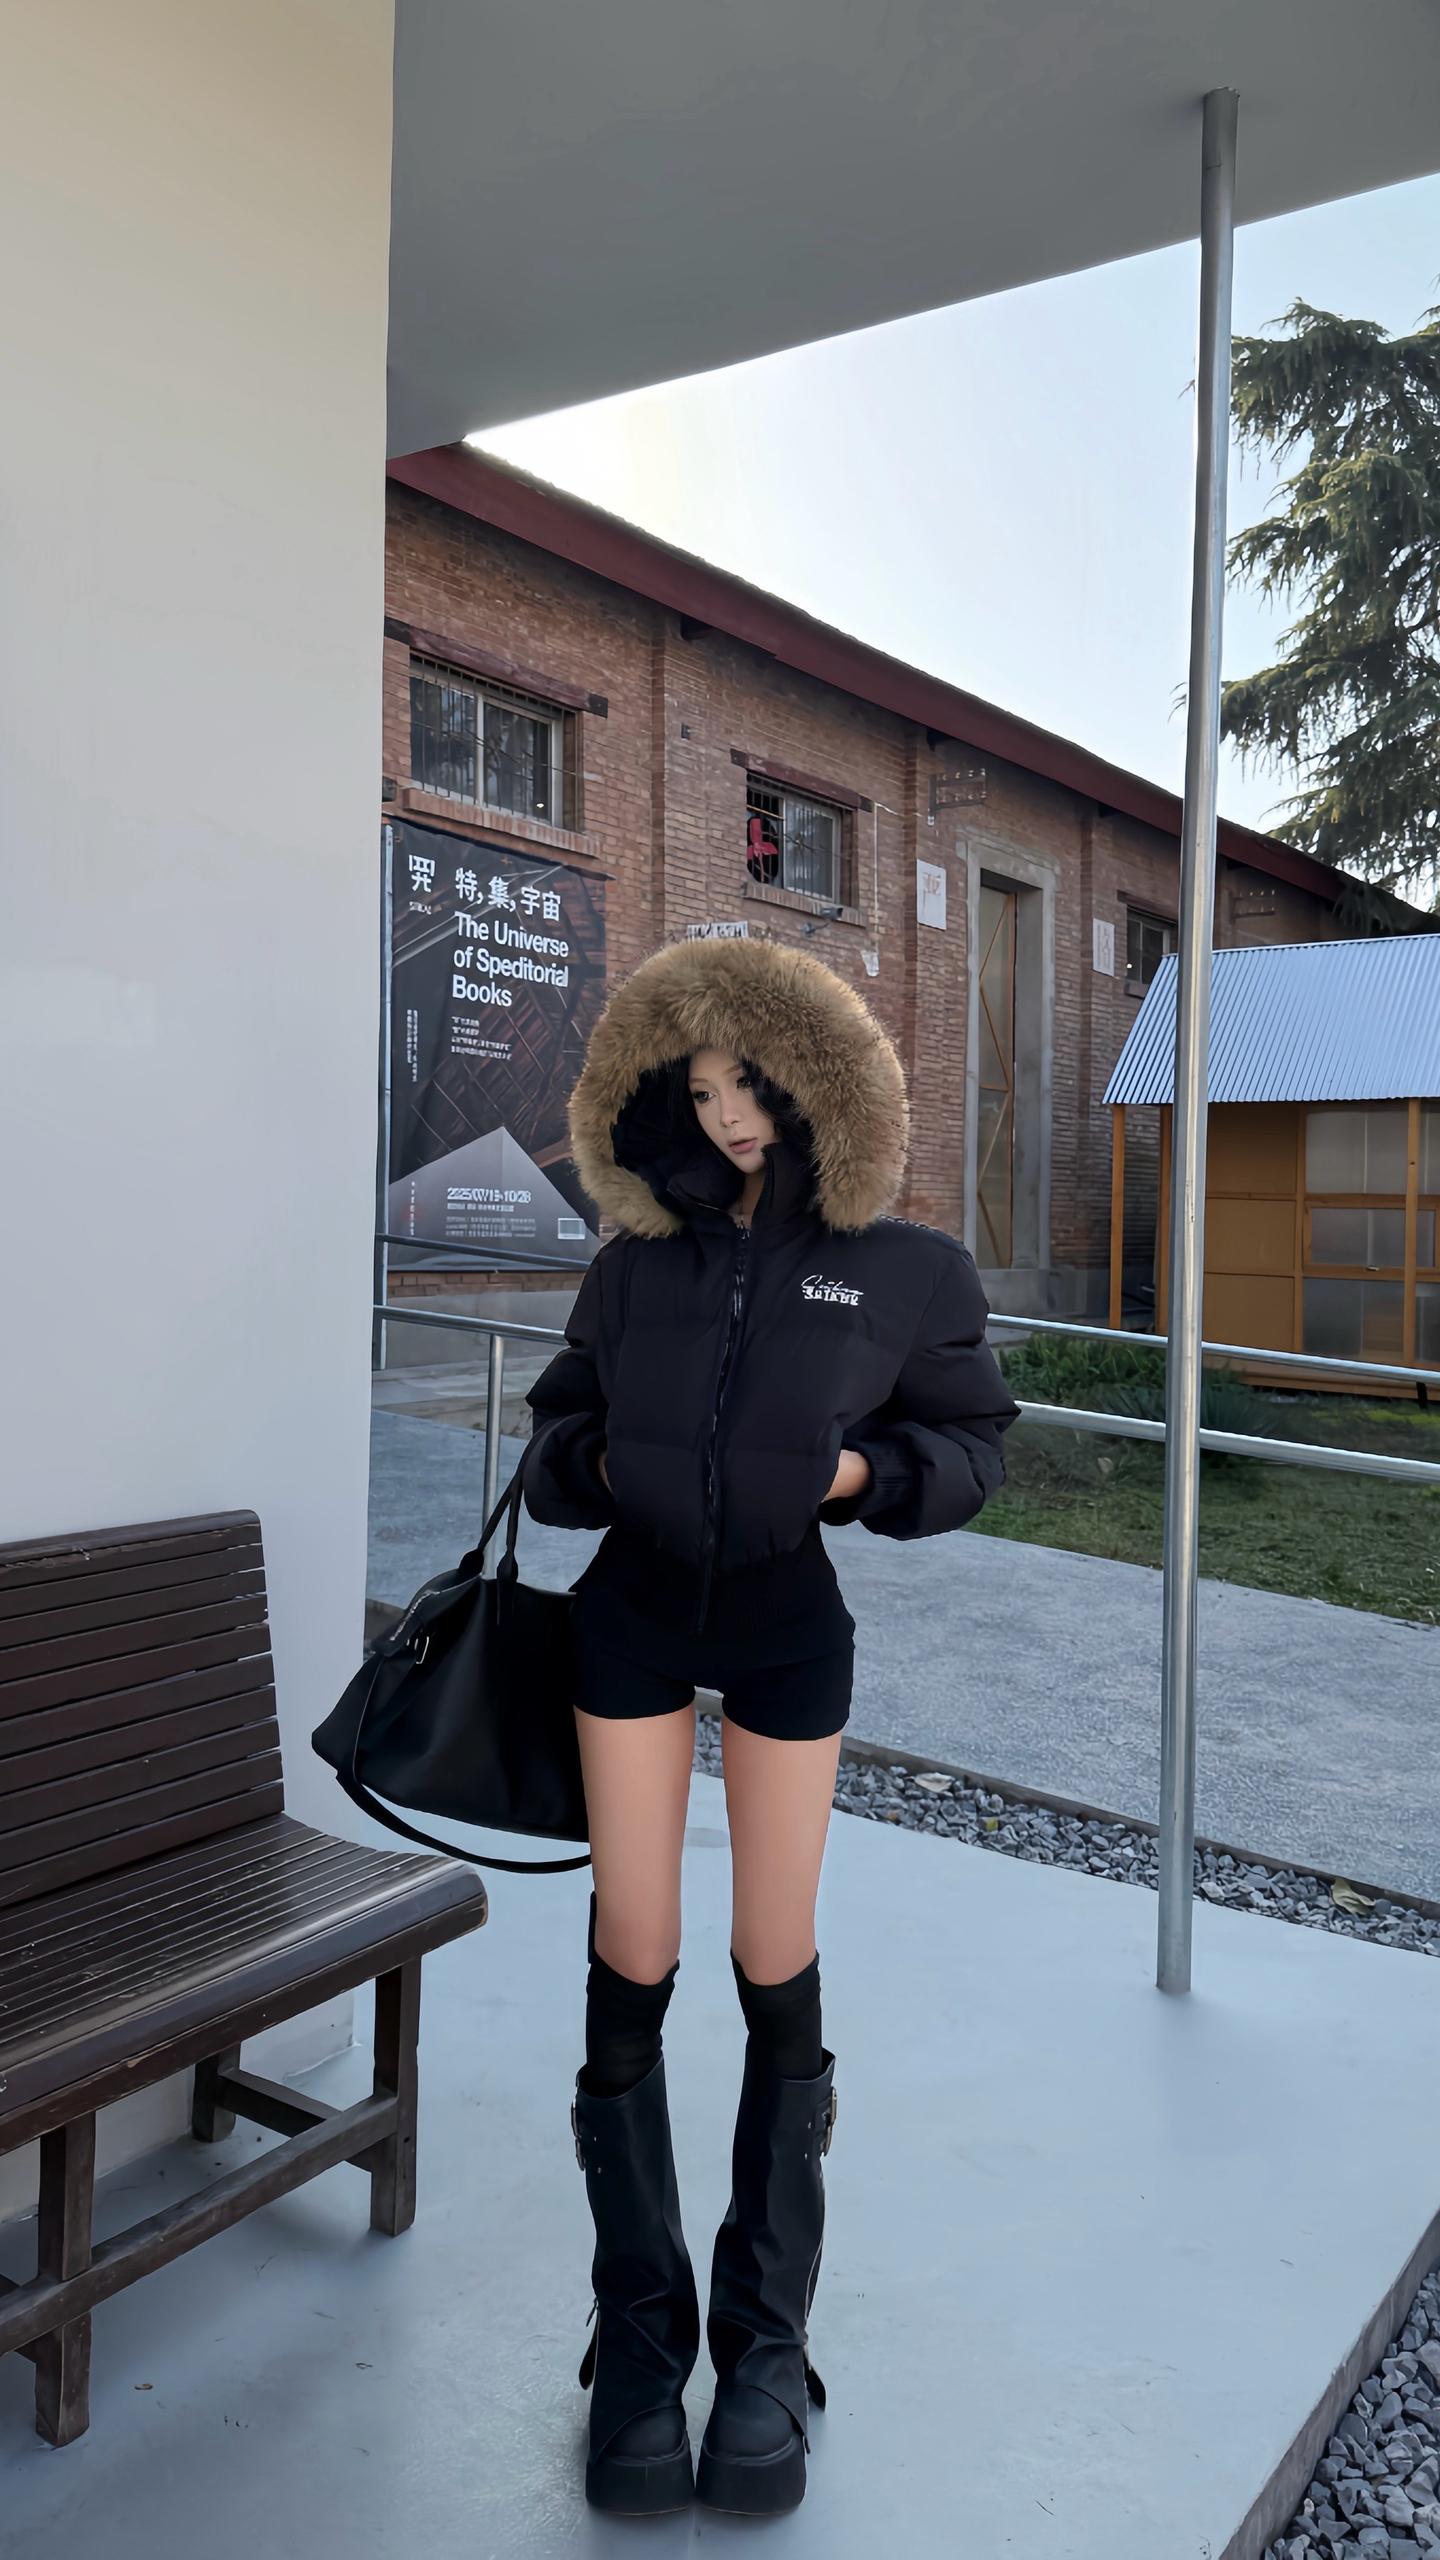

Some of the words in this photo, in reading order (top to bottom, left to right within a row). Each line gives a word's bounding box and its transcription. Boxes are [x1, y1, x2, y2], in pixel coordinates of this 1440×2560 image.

[454, 910, 489, 940] The
[494, 920, 569, 957] Universe
[453, 946, 474, 968] of
[476, 948, 569, 988] Speditorial
[452, 974, 513, 1007] Books
